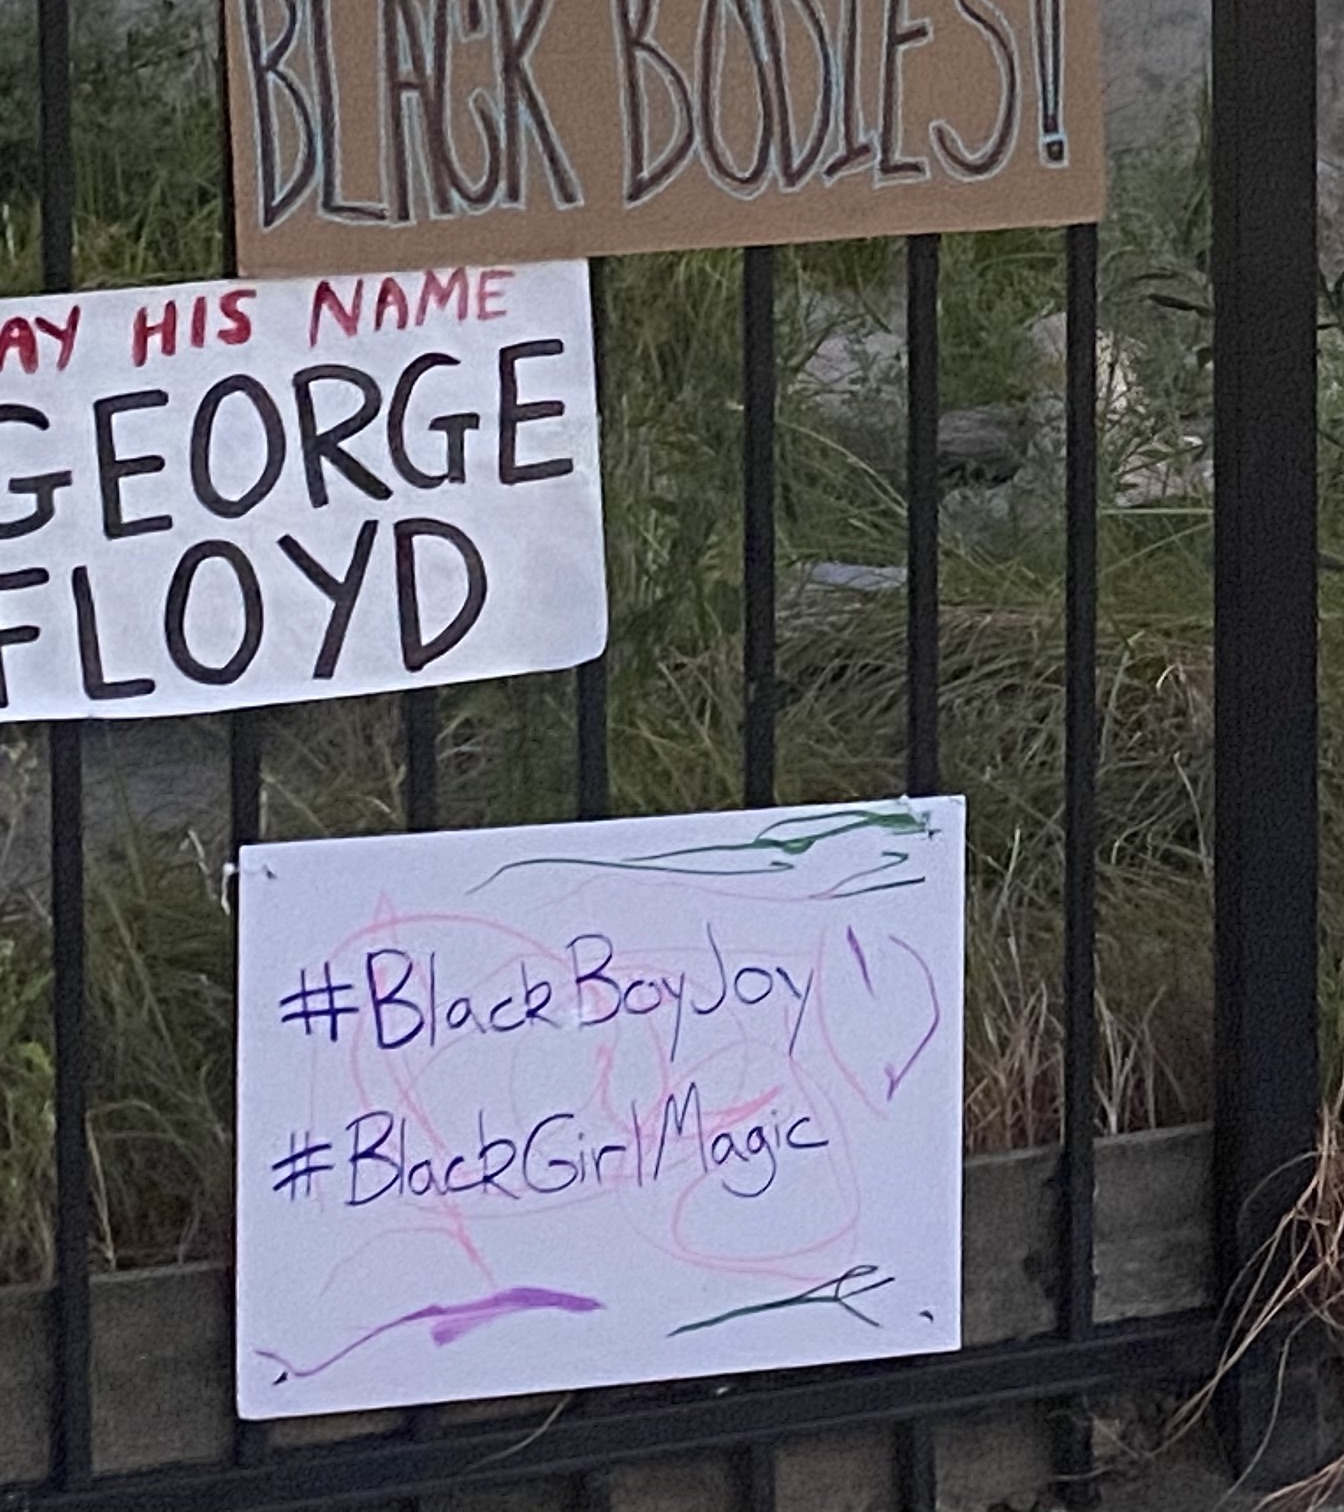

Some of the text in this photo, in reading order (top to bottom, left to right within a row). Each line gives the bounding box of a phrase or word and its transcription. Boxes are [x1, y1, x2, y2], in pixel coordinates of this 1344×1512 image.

[131, 289, 257, 367] HIS
[309, 266, 516, 348] NAME
[0, 339, 574, 540] GEORGE
